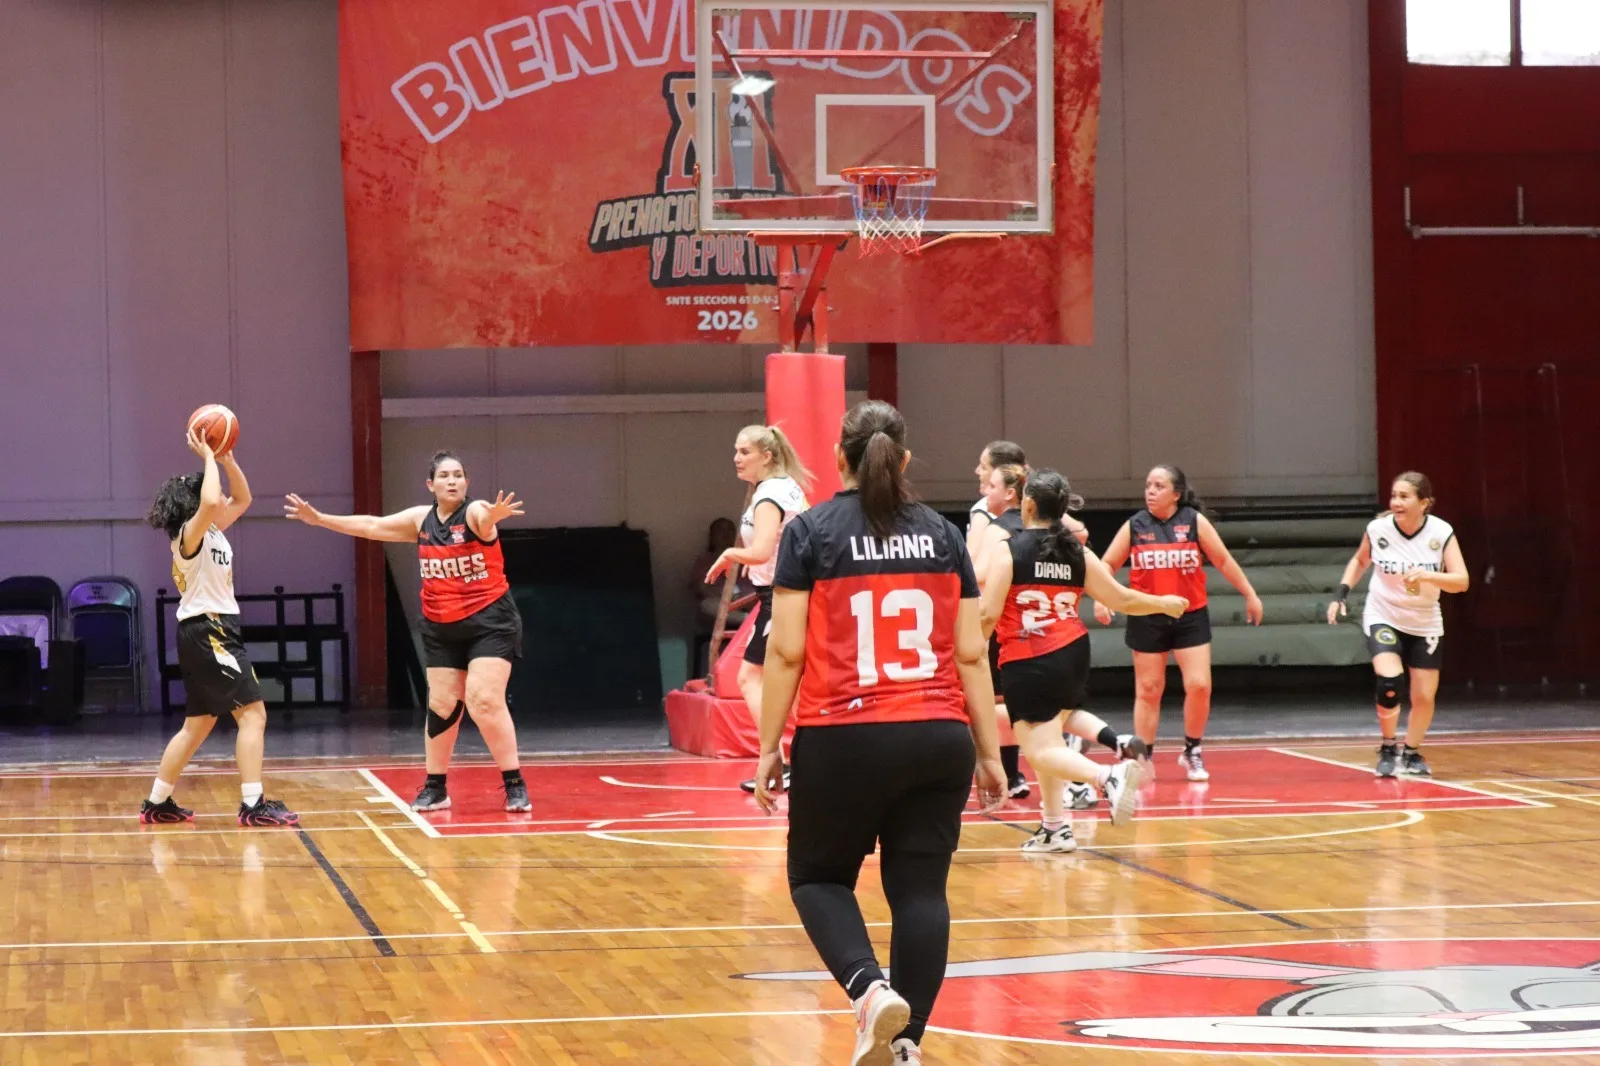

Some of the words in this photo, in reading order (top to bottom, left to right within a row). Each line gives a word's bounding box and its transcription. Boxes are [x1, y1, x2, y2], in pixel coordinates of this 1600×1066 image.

[652, 236, 667, 280] Y
[665, 295, 691, 306] SNTE
[693, 295, 737, 305] SECCION
[697, 310, 759, 331] 2026
[850, 534, 936, 561] LILIANA
[1034, 561, 1072, 581] DIANA
[1130, 550, 1200, 571] LIEBRES
[850, 588, 939, 688] 13
